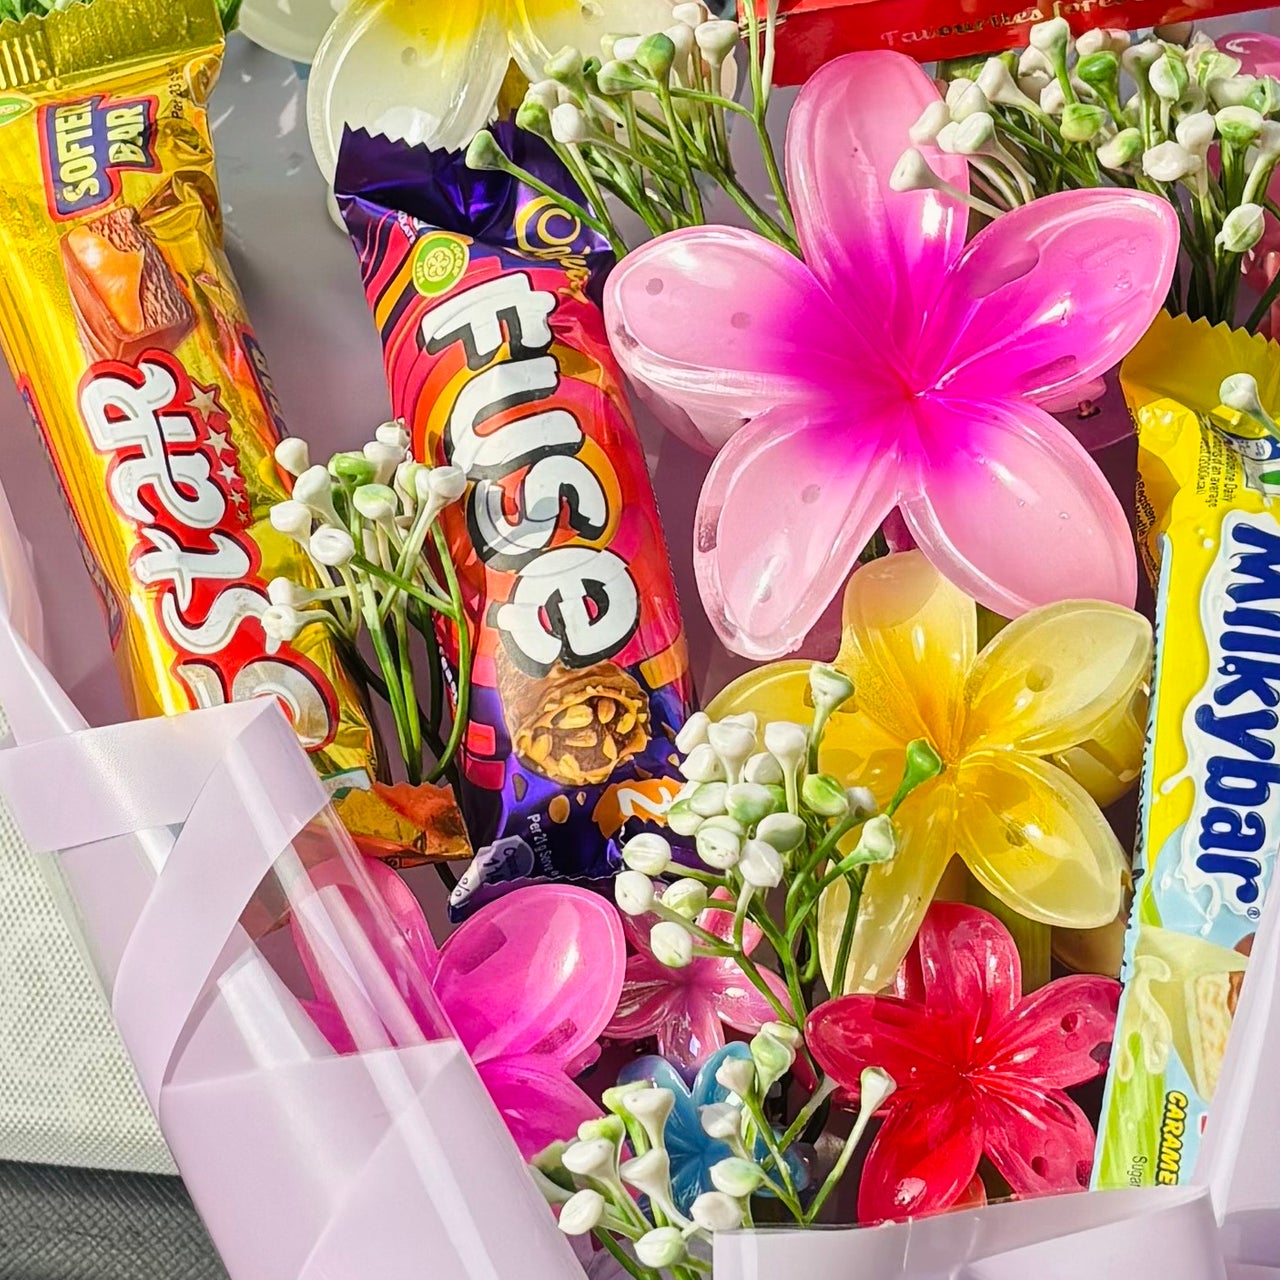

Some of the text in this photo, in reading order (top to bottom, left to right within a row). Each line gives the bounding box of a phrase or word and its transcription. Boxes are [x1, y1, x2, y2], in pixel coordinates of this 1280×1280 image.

[54, 99, 147, 204] SOFTER BAR
[526, 813, 542, 834] Per
[1154, 1089, 1189, 1186] CARAME
